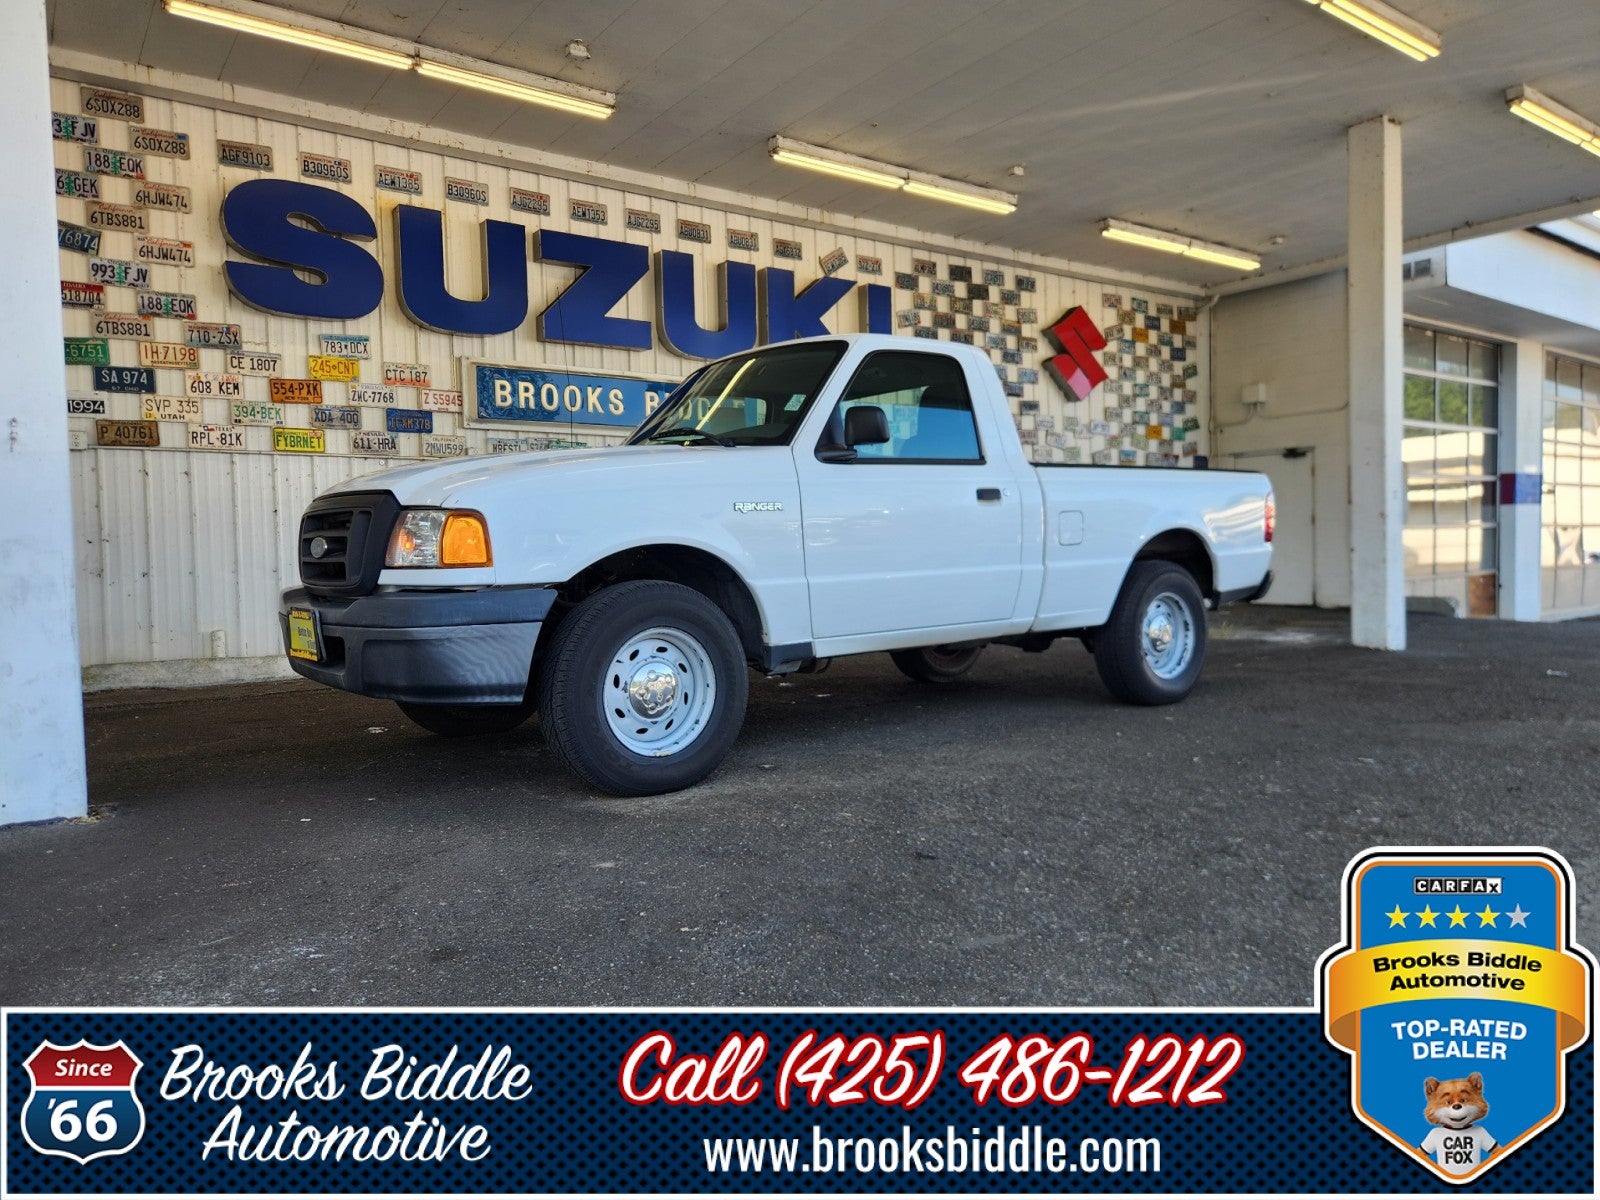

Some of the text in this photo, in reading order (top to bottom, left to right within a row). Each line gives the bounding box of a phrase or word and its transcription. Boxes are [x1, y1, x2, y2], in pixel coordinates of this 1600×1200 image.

[87, 152, 111, 169] 188
[222, 149, 270, 167] AGF9103
[135, 190, 188, 209] 6HJW474
[91, 211, 145, 229] 6TBS881
[139, 245, 191, 264] 6HJW474
[91, 263, 116, 279] 993
[220, 178, 893, 361] SUZUKI
[140, 295, 163, 311] 188
[96, 321, 151, 337] 6TBS881
[230, 356, 278, 372] CE 1807
[102, 369, 148, 385] SA 974
[385, 369, 428, 384] CTC 187
[190, 381, 240, 395] 608 KEM
[494, 379, 625, 416] BROOKS
[68, 400, 105, 414] 1994
[145, 399, 200, 414] SVP 335
[161, 413, 186, 421] UTAH
[191, 431, 243, 446] RPL 81K
[734, 502, 783, 513] RANGER
